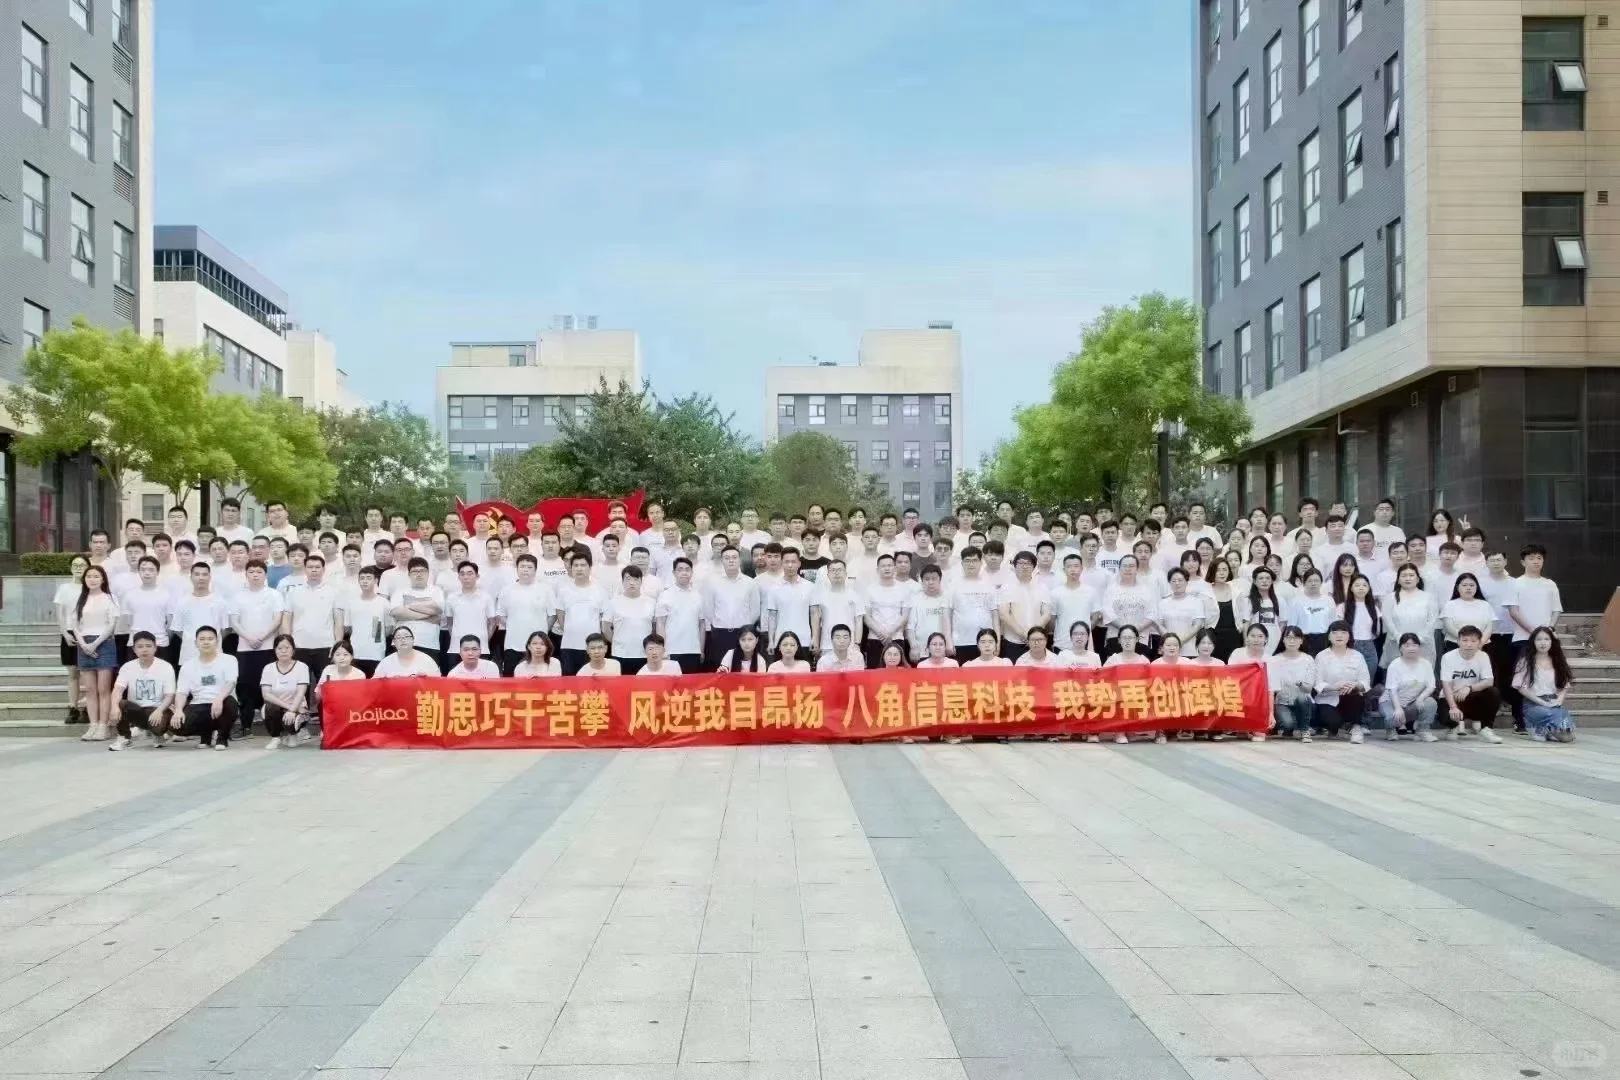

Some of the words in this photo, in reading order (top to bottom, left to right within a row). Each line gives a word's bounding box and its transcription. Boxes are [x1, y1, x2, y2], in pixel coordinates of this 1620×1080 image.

[1451, 668, 1477, 680] FILA
[135, 679, 156, 701] M
[349, 707, 409, 725] bajiao
[415, 690, 610, 737] 勤思巧干苦攀
[628, 685, 824, 736] 风逆我自昂扬
[842, 680, 1037, 729] 八角信息科技
[1053, 676, 1245, 720] 我势再创辉煌
